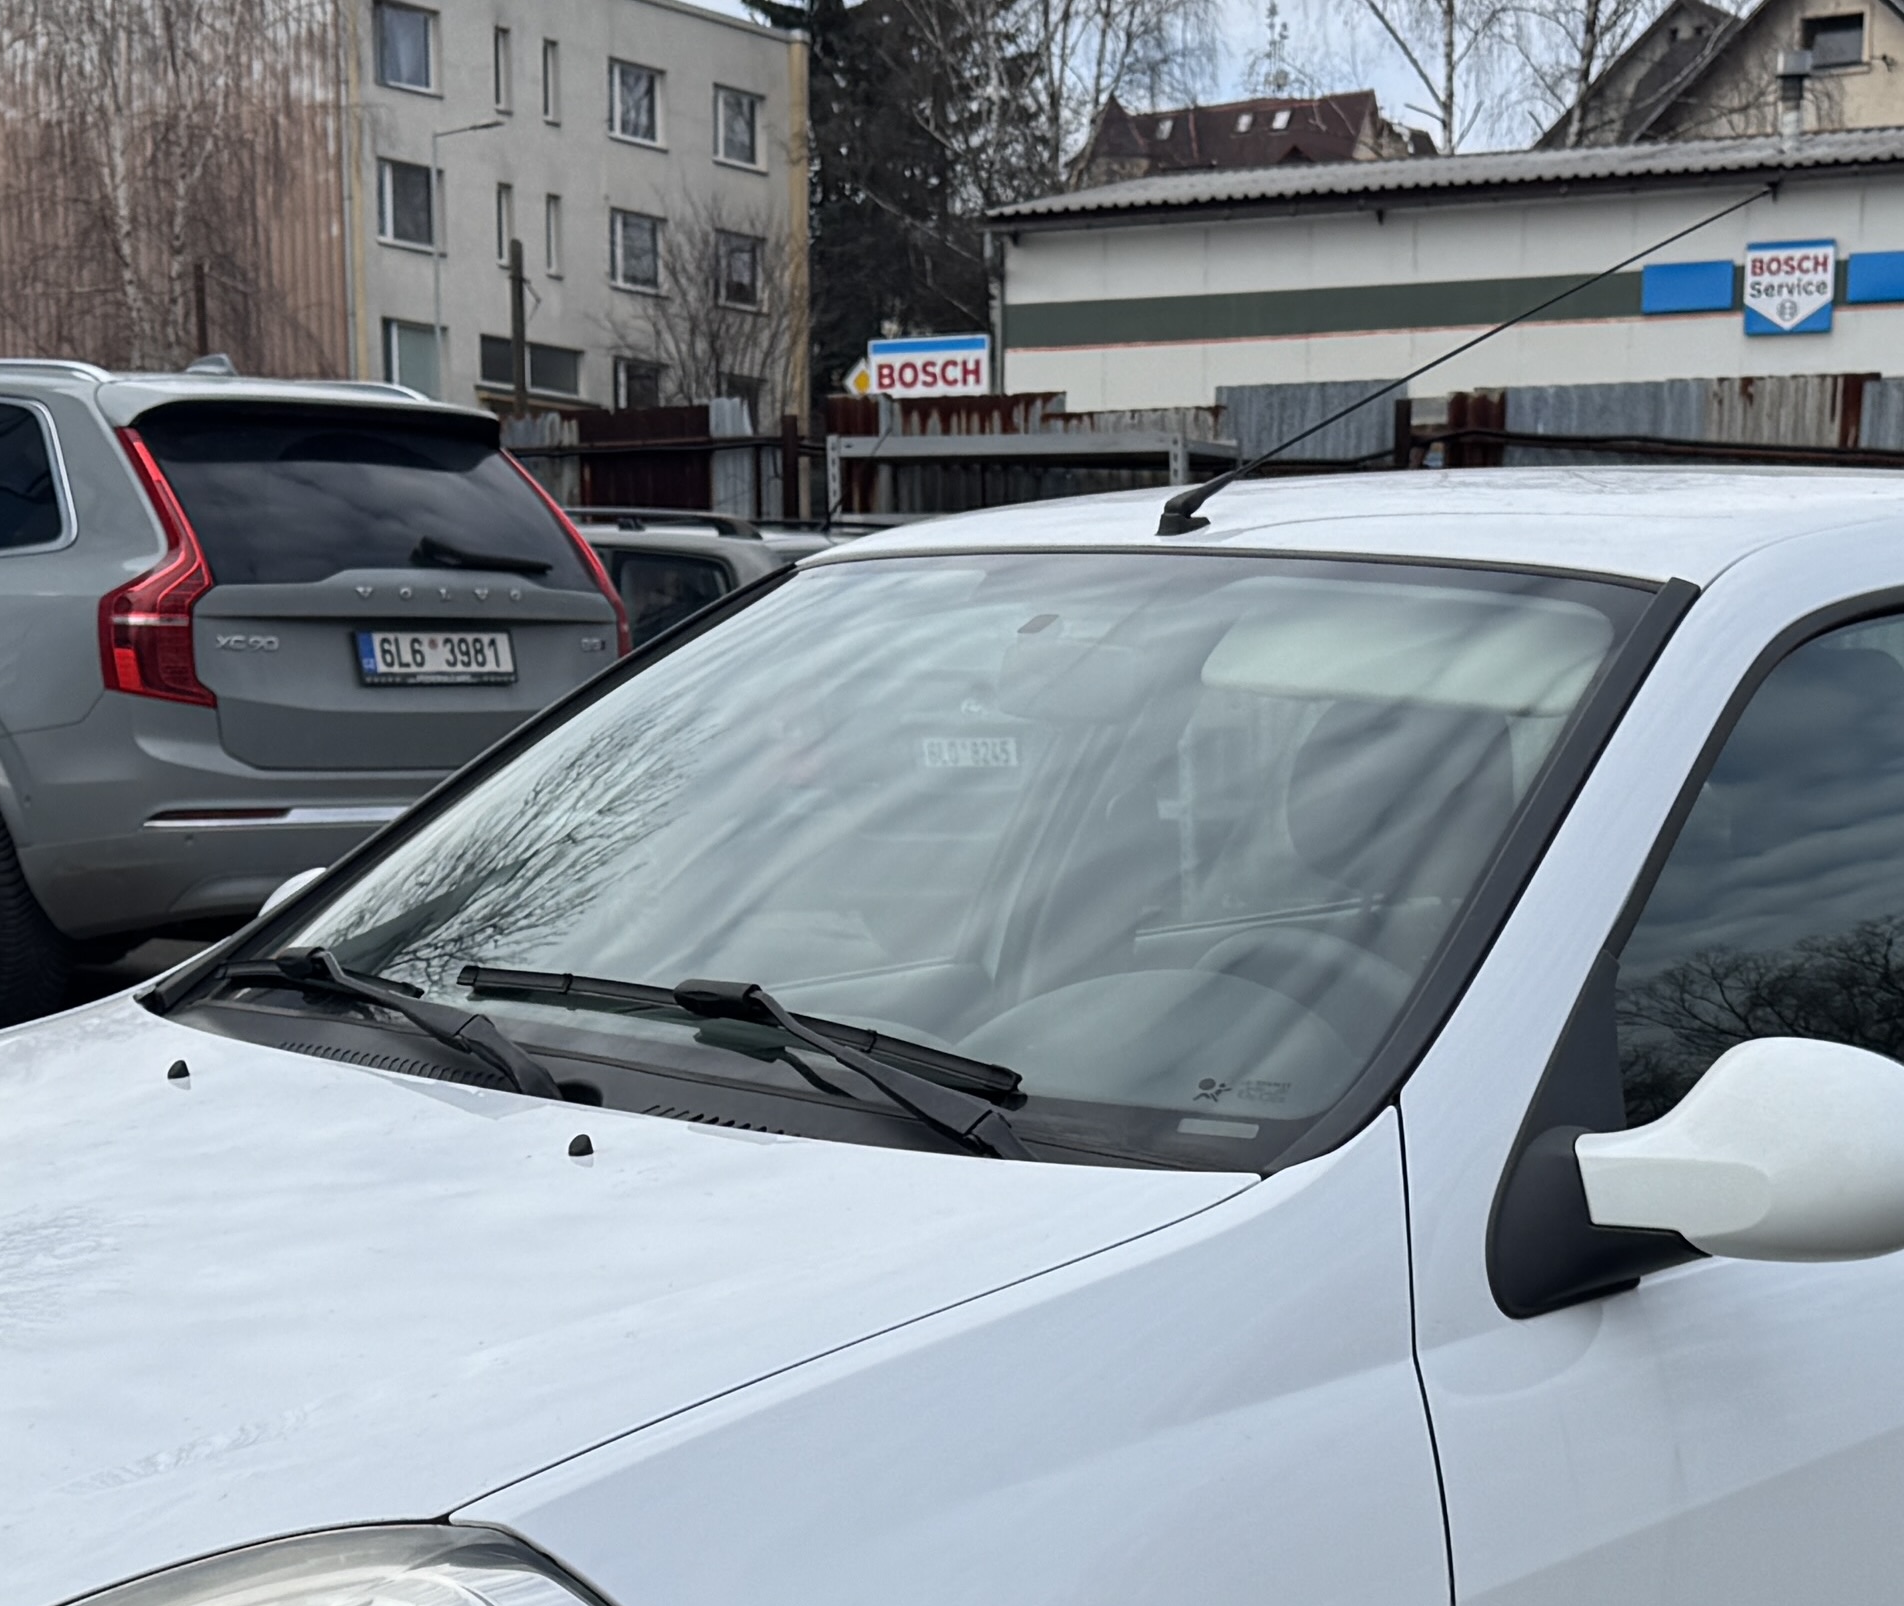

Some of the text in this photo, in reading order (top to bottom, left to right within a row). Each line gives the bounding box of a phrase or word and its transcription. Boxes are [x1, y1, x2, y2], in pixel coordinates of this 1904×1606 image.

[1750, 254, 1829, 276] BOSCH
[1749, 277, 1828, 298] Service
[877, 358, 981, 390] BOSCH
[380, 637, 501, 668] 6L6 3981
